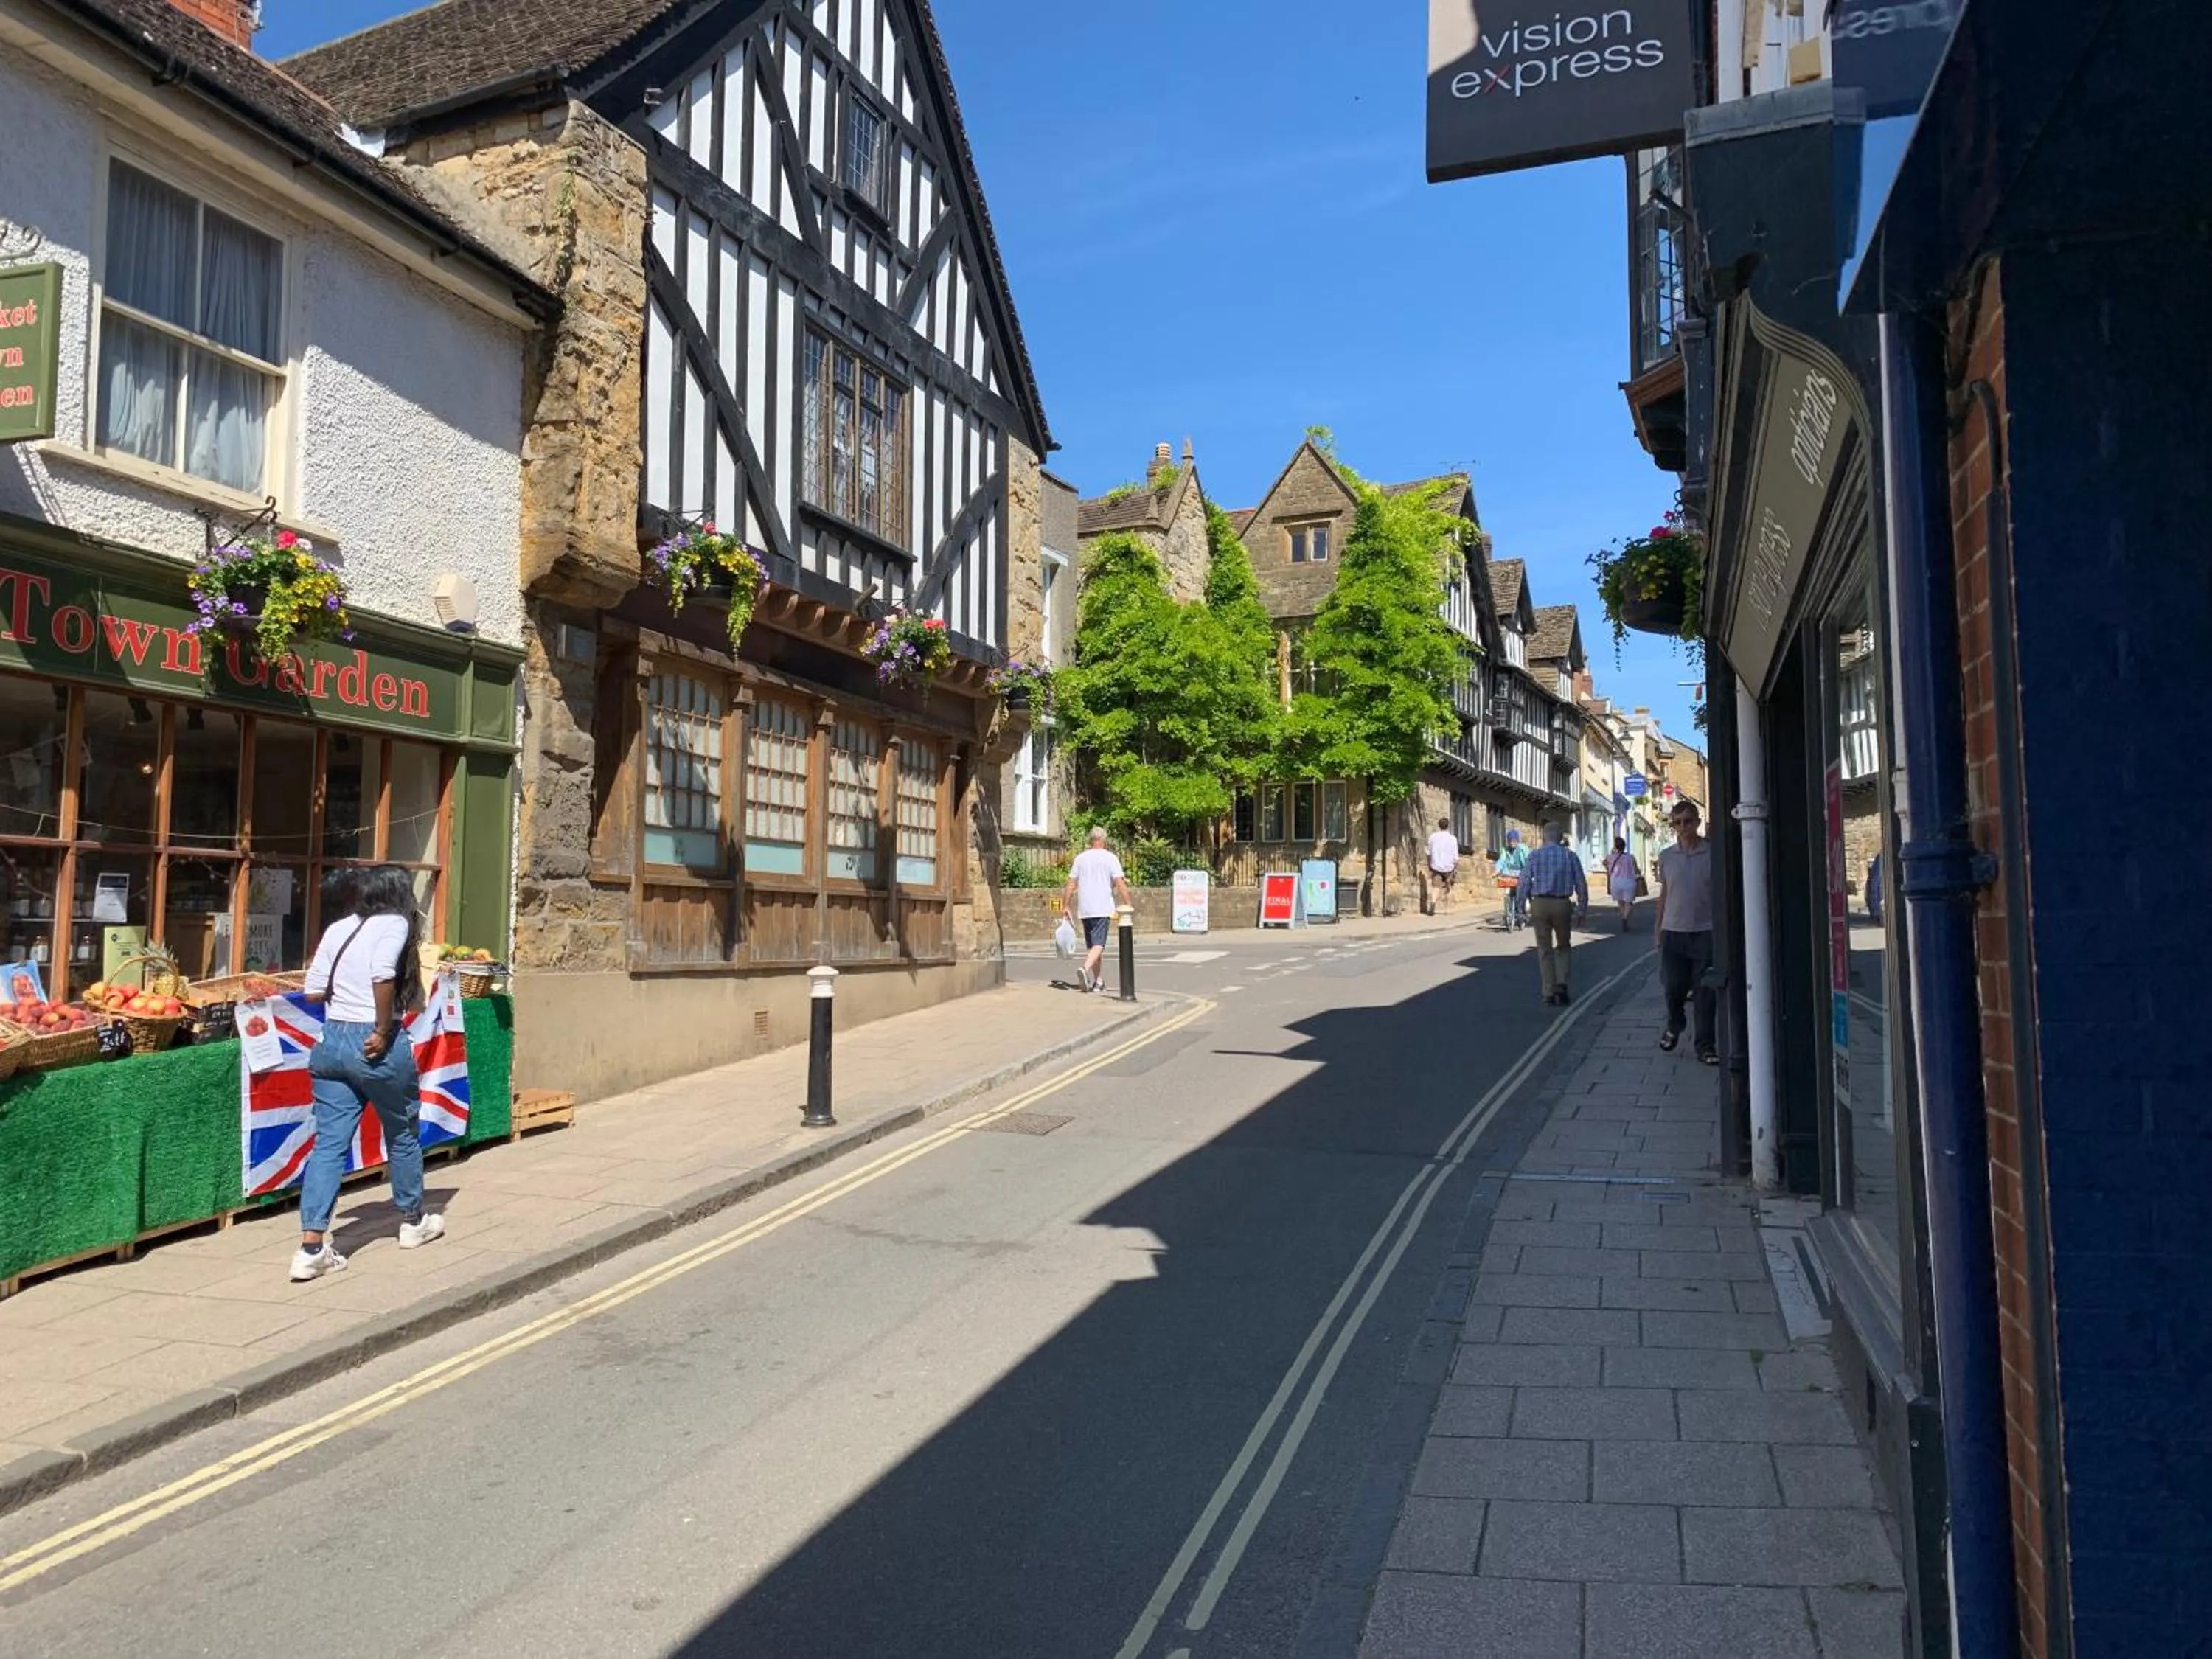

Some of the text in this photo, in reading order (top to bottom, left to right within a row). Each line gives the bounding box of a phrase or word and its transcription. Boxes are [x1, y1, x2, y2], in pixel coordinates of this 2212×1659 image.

[1450, 39, 1664, 97] express
[1481, 10, 1632, 58] vision
[1790, 369, 1837, 488] opticians
[0, 568, 431, 717] Town Garden
